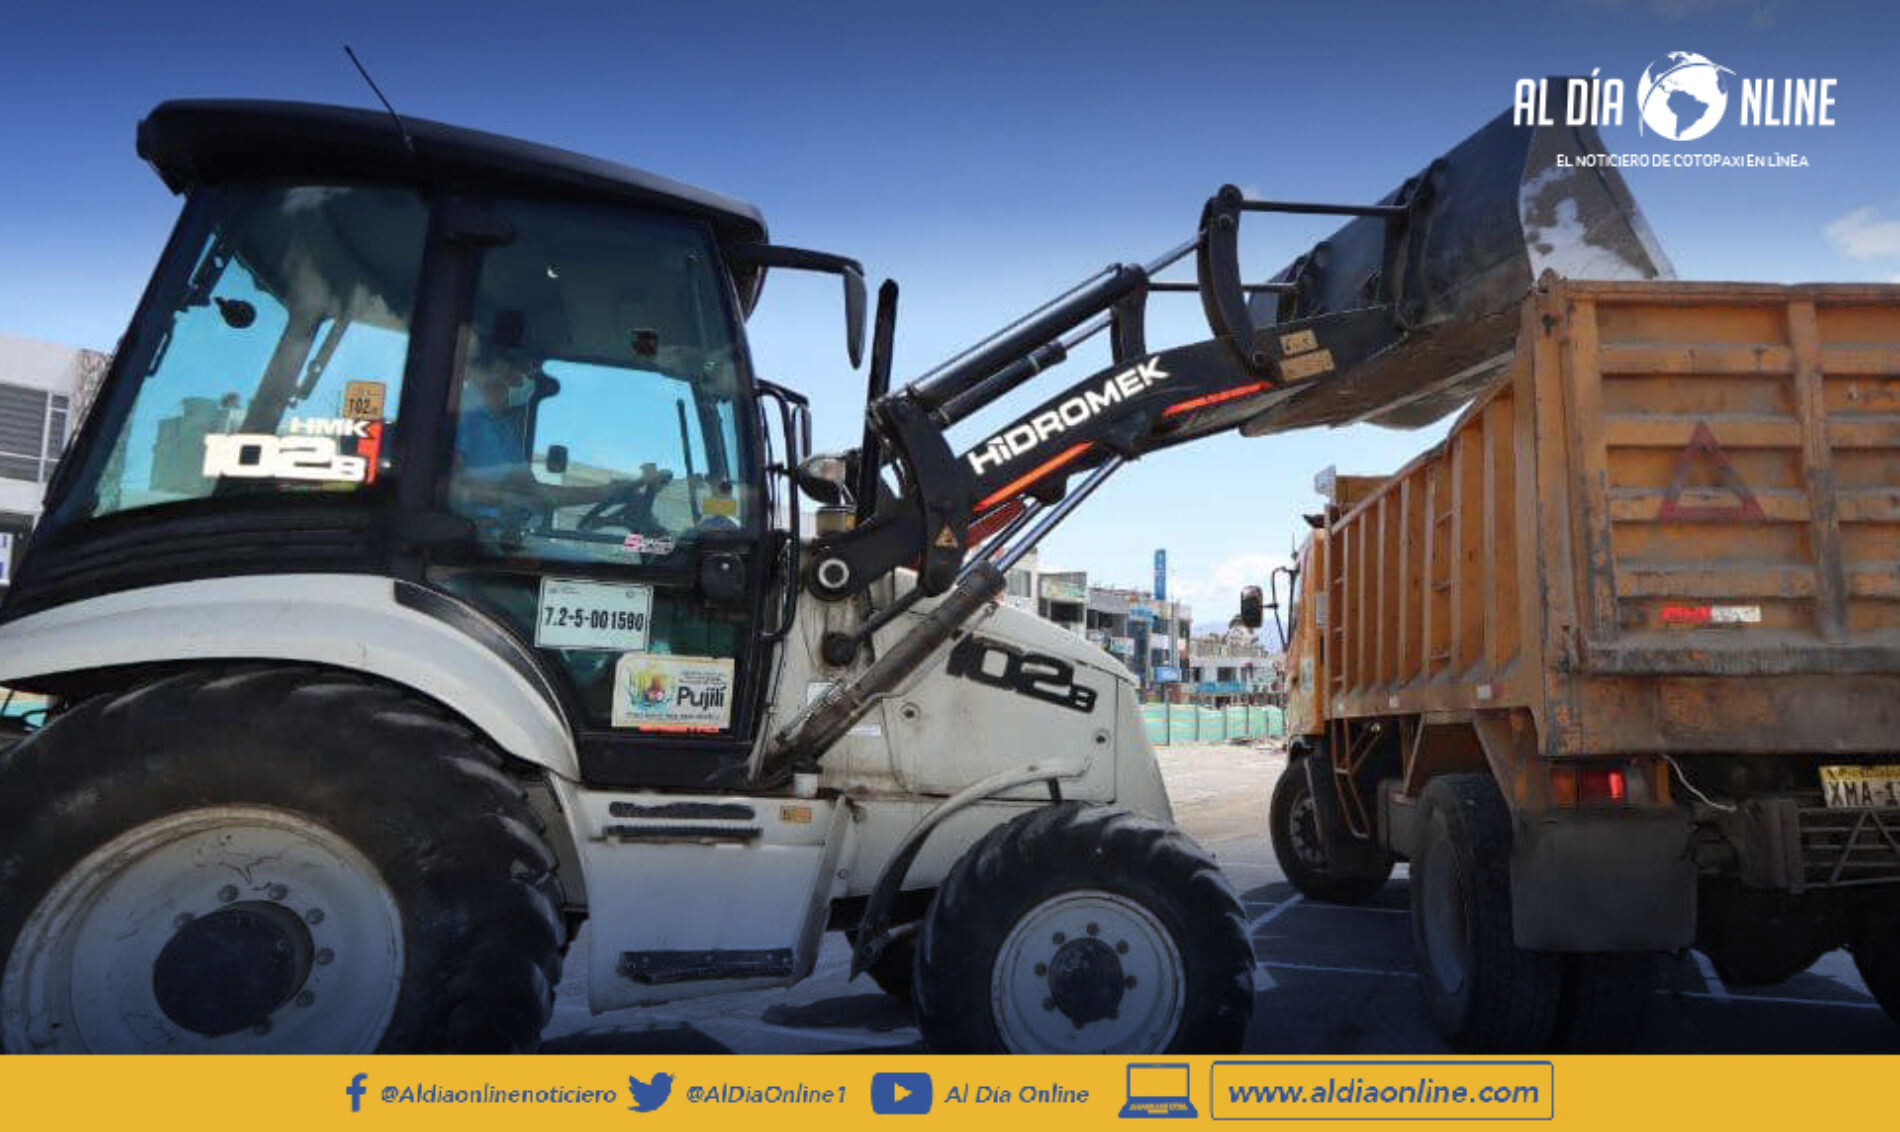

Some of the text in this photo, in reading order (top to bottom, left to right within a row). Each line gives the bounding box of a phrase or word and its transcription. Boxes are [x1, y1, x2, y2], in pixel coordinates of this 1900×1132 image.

[290, 416, 371, 437] HMK
[544, 606, 645, 632] 7.2-5-001590
[676, 685, 727, 711] Pujilí
[1827, 781, 1900, 806] XMA-1
